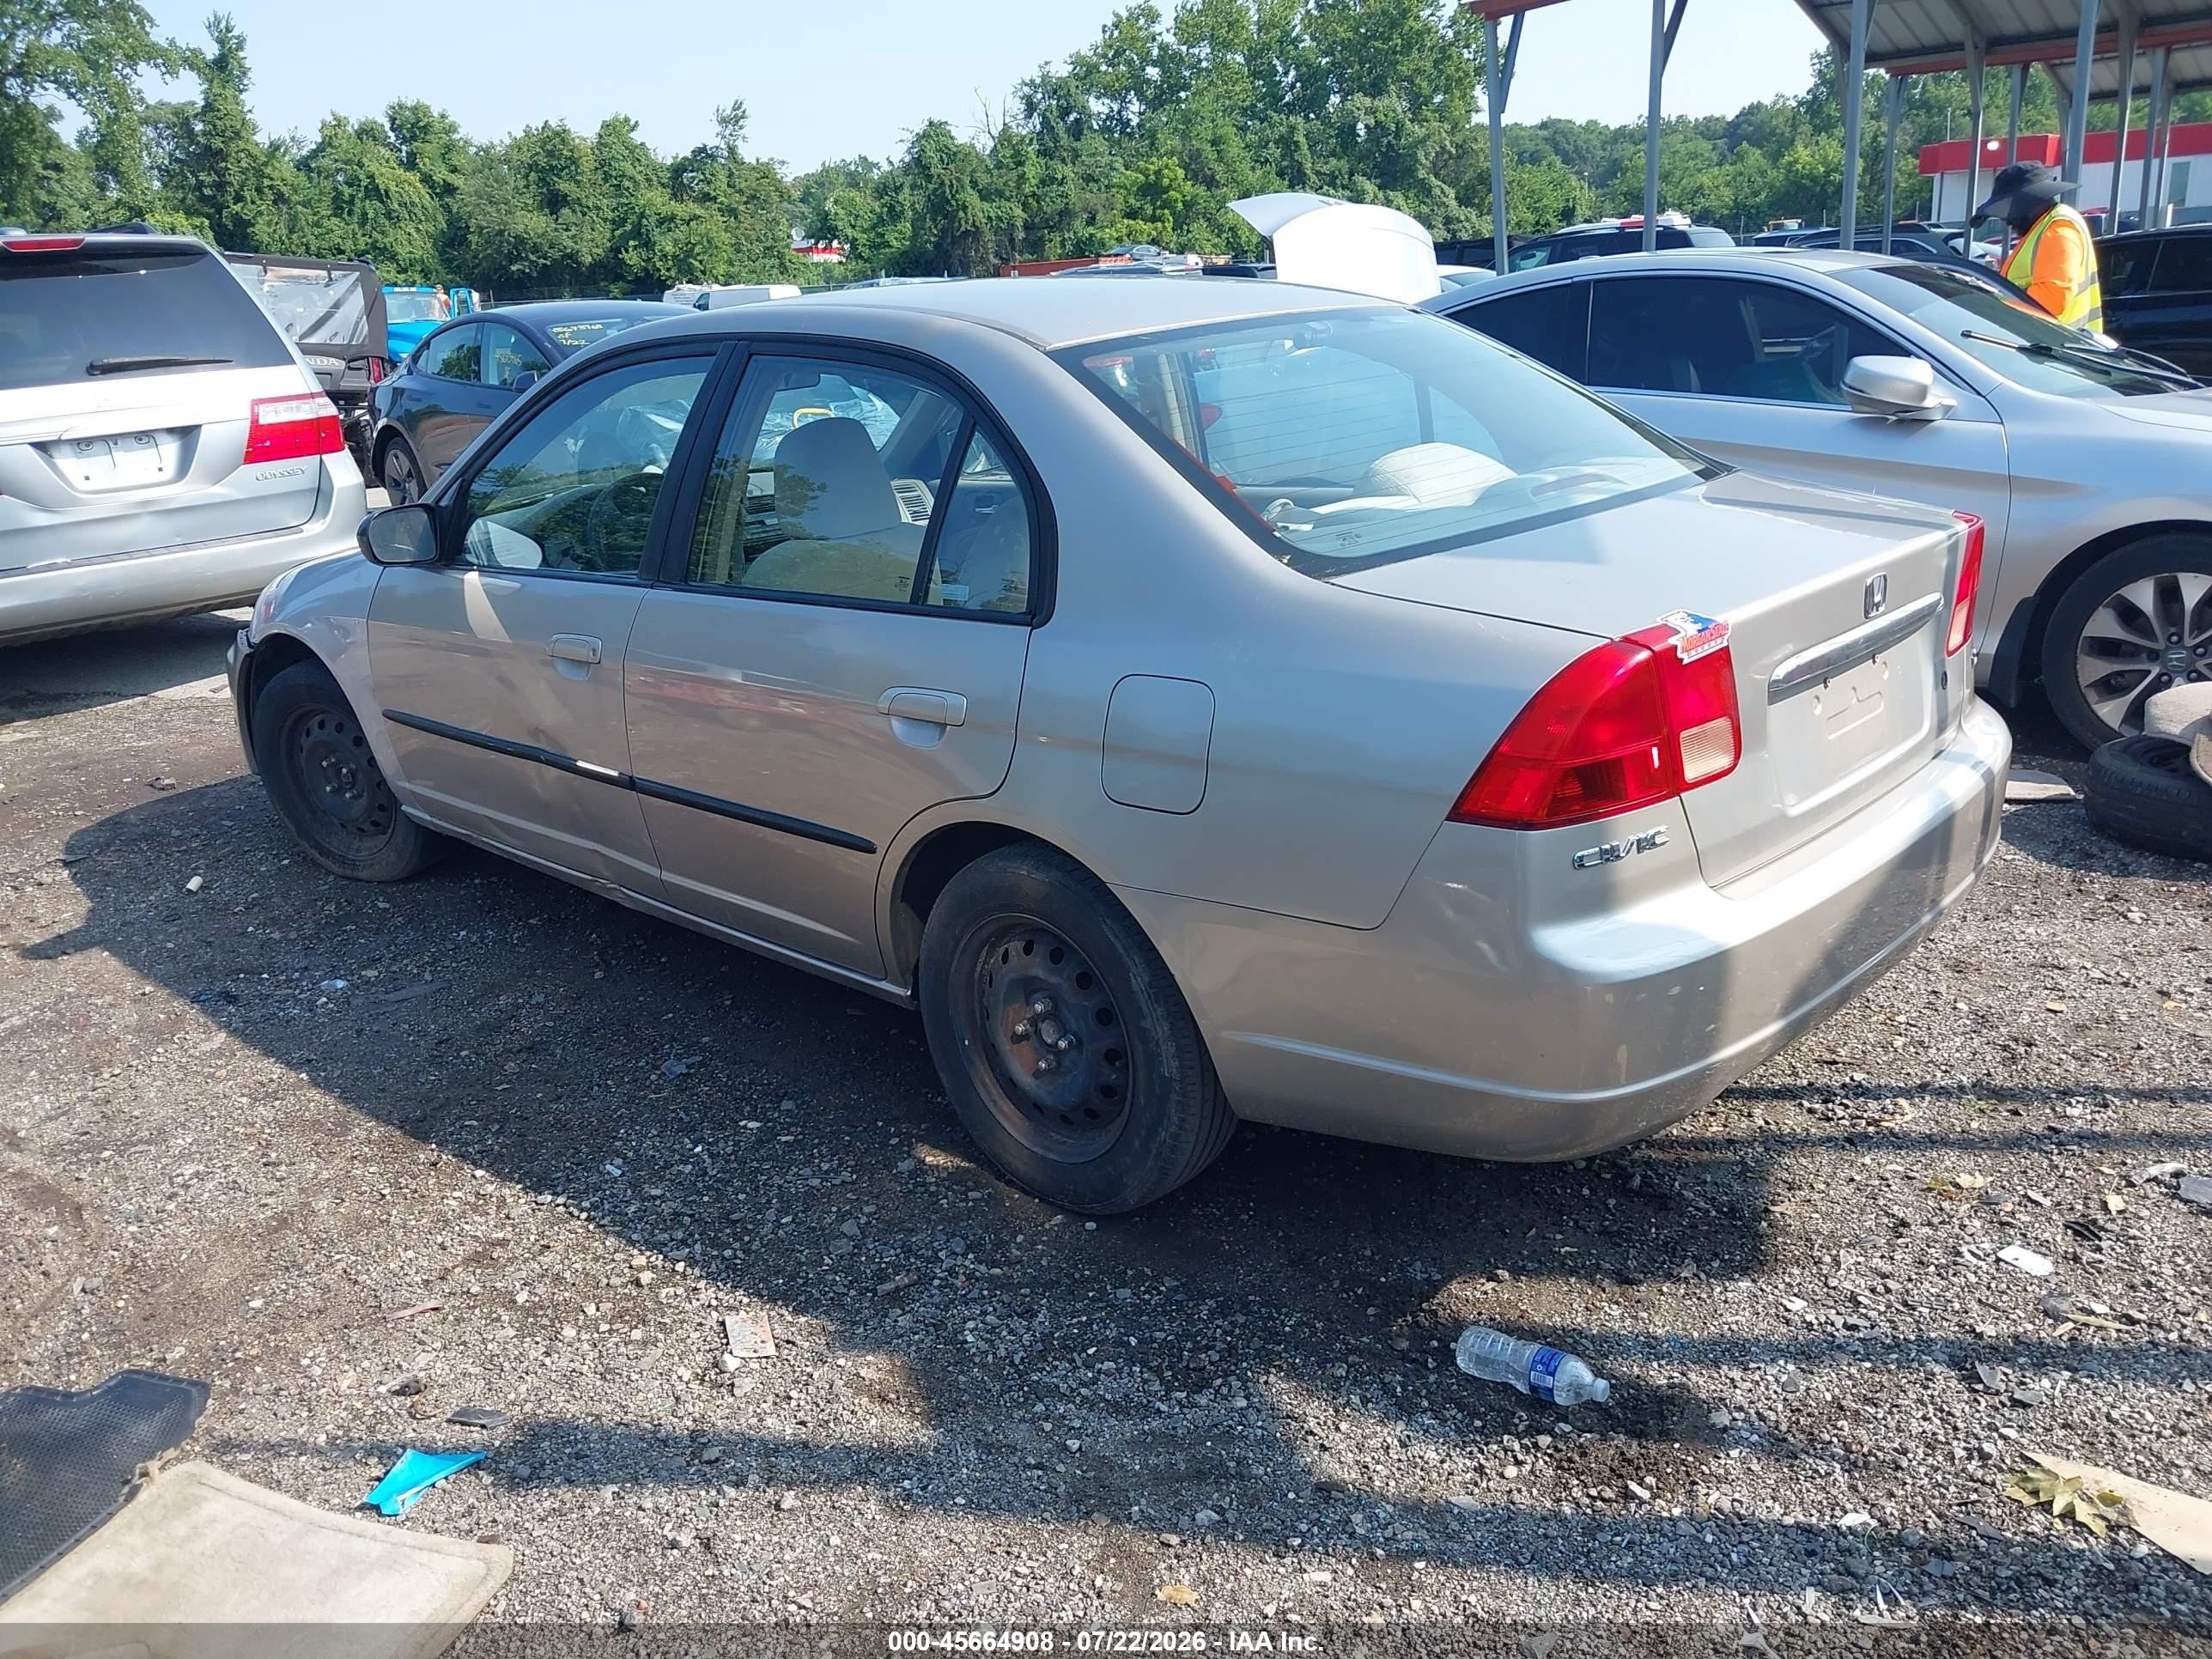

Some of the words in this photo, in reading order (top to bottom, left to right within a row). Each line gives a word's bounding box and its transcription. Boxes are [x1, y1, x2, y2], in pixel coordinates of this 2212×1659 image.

[306, 356, 339, 366] NDA
[255, 466, 307, 482] ODYSSEY
[1680, 630, 1711, 653] MORGAN
[1572, 825, 1669, 870] CIVIC
